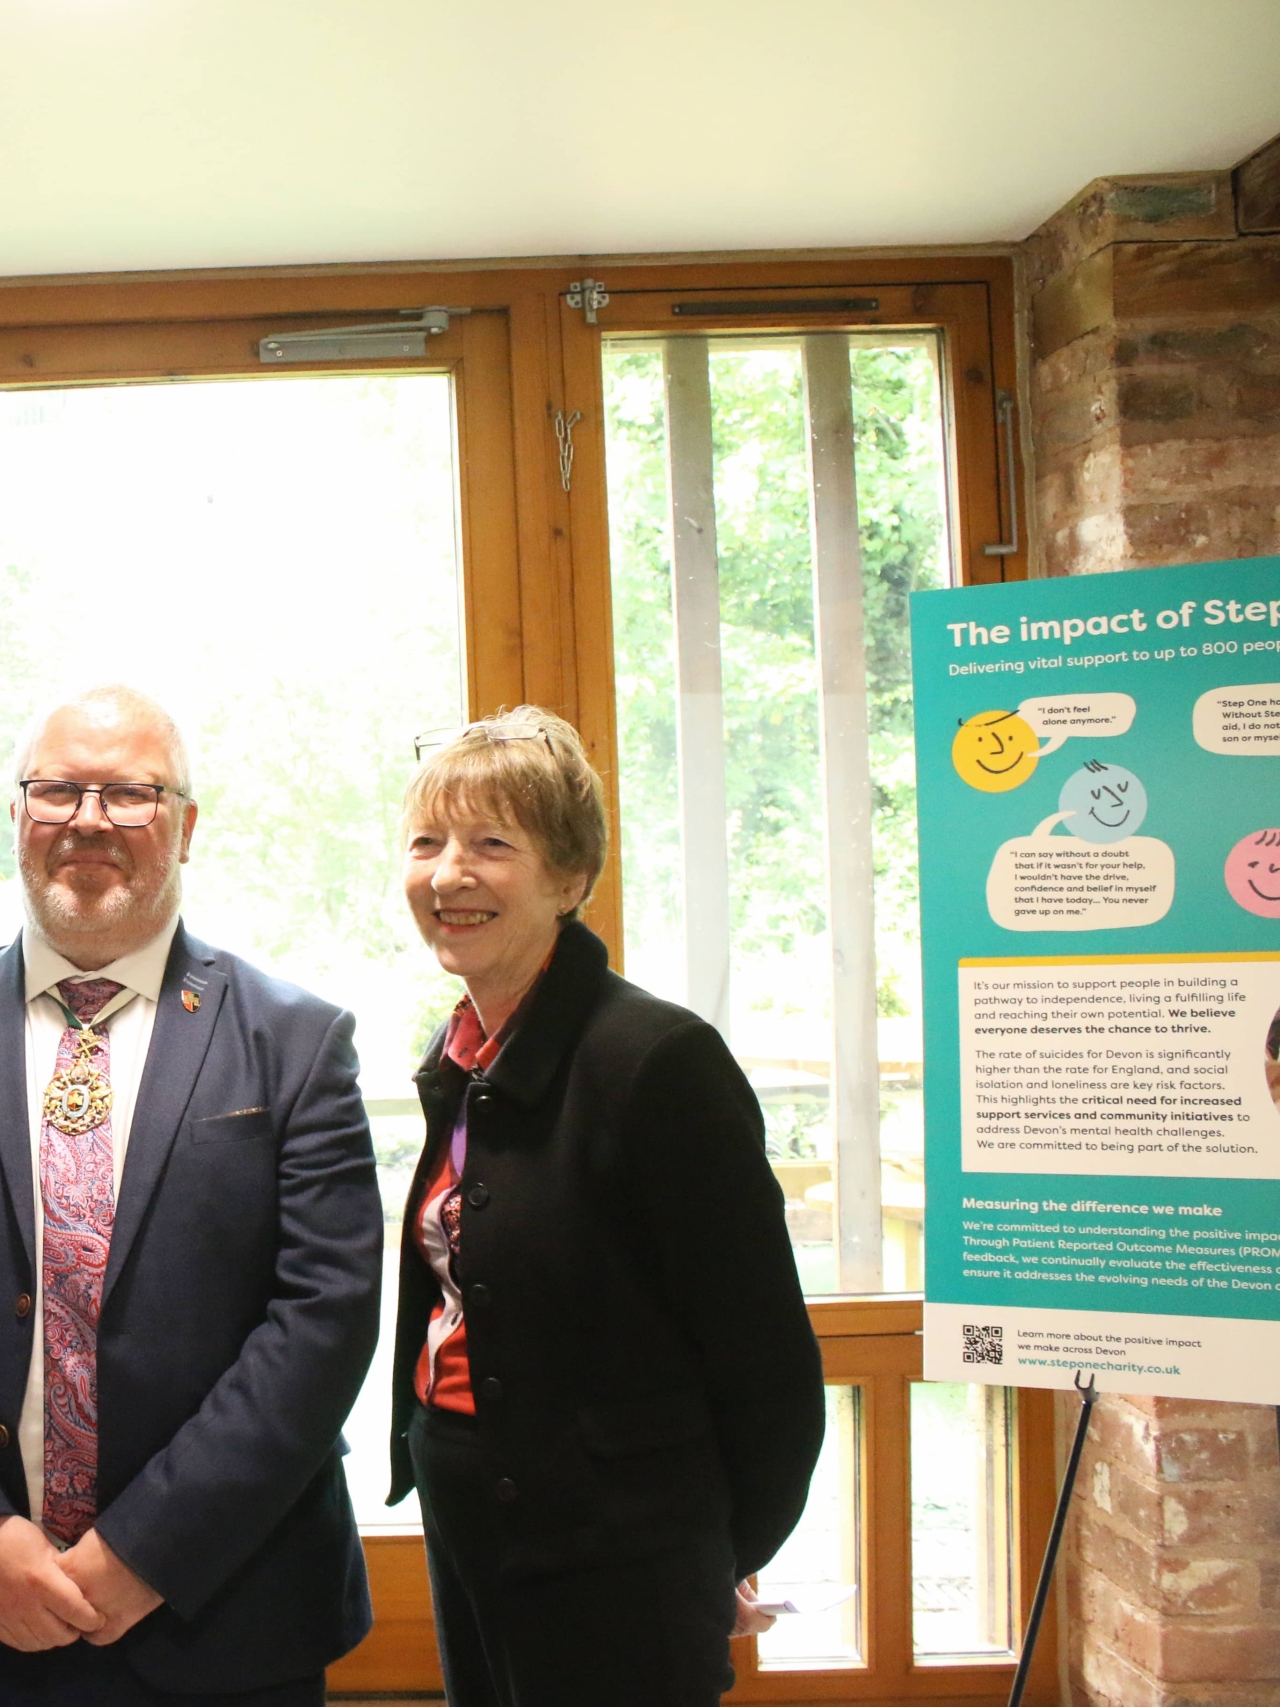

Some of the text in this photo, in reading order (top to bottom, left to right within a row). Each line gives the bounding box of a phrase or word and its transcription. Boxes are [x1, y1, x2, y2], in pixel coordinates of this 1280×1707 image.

[946, 621, 1010, 647] The
[1020, 608, 1147, 645] impact
[1156, 601, 1196, 630] of
[949, 660, 1024, 676] Delivering
[1028, 655, 1062, 669] vital
[1067, 651, 1128, 668] support
[1132, 650, 1149, 661] to
[1154, 649, 1175, 662] up
[1179, 646, 1197, 657] to
[1202, 641, 1238, 655] 800
[1042, 718, 1067, 726] alone
[1013, 980, 1054, 990] mission
[1057, 981, 1069, 989] to
[1072, 980, 1117, 991] support
[1120, 978, 1160, 990] people
[1164, 978, 1174, 987] in
[1178, 977, 1227, 989] building
[1230, 979, 1238, 987] a
[974, 992, 1246, 1007] pathway to independence, living a fulfilling life
[974, 1008, 1236, 1022] and reaching their own potential. We believe
[974, 1023, 1211, 1037] everyone deserves the chance to thrive.
[975, 1049, 1231, 1062] The rate of suicides for Devon is significantly
[976, 1095, 1242, 1107] This highlights the critical need for increased
[976, 1110, 1250, 1123] support services and community initiatives to
[962, 1197, 1223, 1217] Measuring the difference we make
[1017, 1330, 1202, 1349] Learn more about the positive impact
[1033, 1344, 1060, 1352] make
[1062, 1346, 1093, 1354] across
[1095, 1346, 1126, 1356] Devon
[1018, 1358, 1181, 1375] www.steponecharity.co.uk
